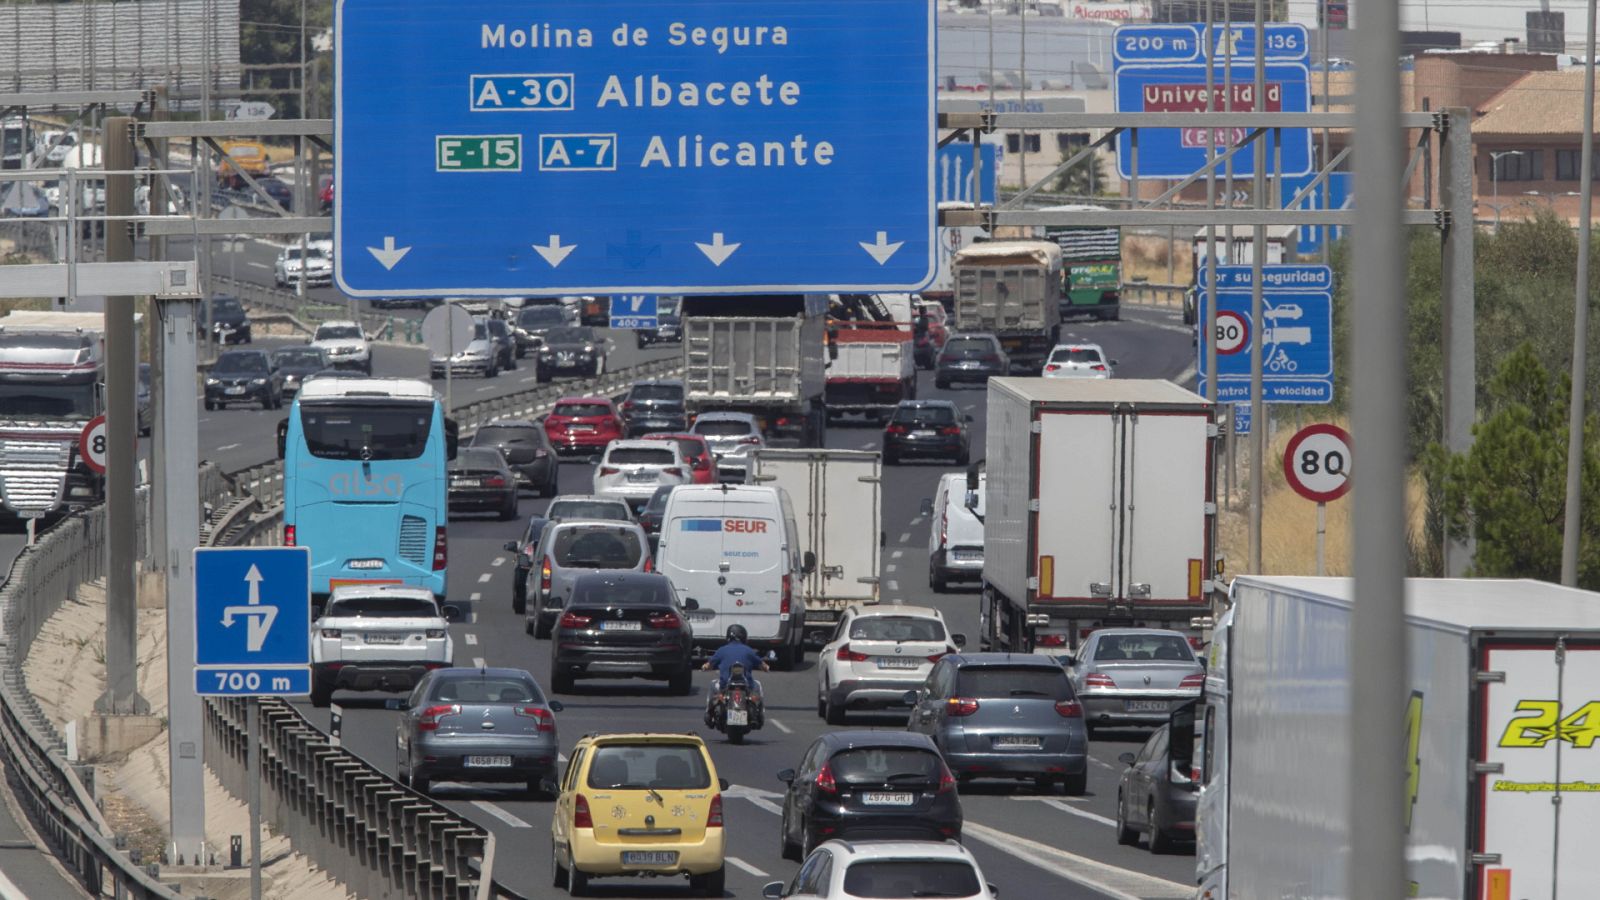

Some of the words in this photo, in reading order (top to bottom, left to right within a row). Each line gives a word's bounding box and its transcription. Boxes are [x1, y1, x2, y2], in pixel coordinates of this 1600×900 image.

[481, 23, 593, 48] Molina
[612, 23, 649, 46] de
[668, 22, 788, 54] Segura
[1125, 36, 1164, 51] 200
[1172, 38, 1188, 51] m
[1266, 35, 1297, 49] 136
[475, 79, 570, 106] A-30
[596, 74, 801, 107] Albacete
[1145, 86, 1280, 104] Universidd
[1184, 128, 1243, 146] (Et)
[440, 140, 517, 167] E-15
[545, 140, 612, 166] A-7
[640, 135, 835, 168] Alicante
[1235, 274, 1250, 282] su
[617, 319, 639, 328] 400
[1216, 325, 1239, 341] 80
[1217, 387, 1249, 396] ontrol
[1273, 387, 1325, 397] velocidad
[1301, 449, 1344, 476] 80
[329, 466, 403, 496] alsa
[724, 519, 767, 533] SEUR
[723, 550, 760, 558] seur.com
[214, 672, 261, 691] 700
[271, 677, 291, 691] m
